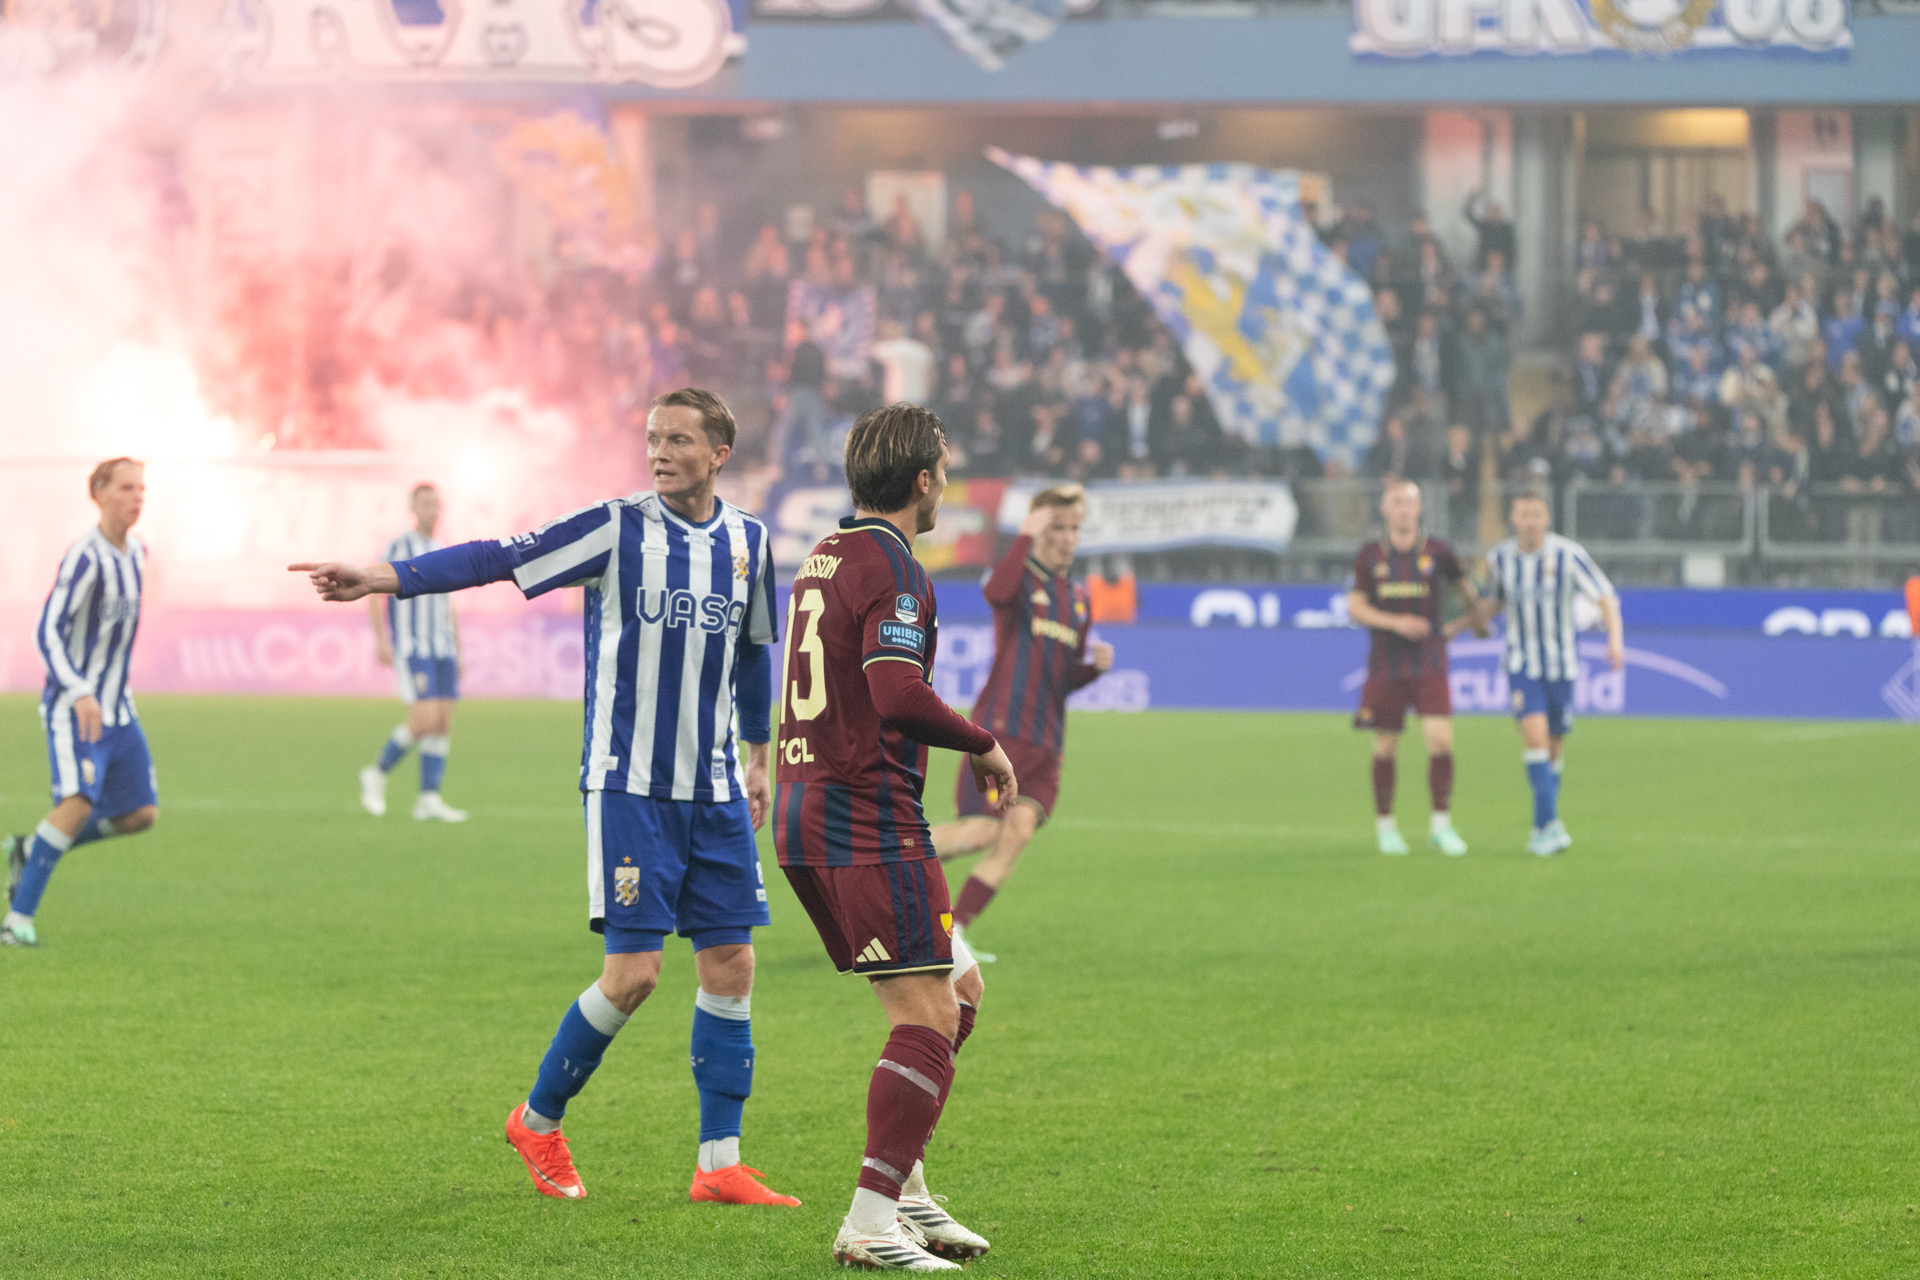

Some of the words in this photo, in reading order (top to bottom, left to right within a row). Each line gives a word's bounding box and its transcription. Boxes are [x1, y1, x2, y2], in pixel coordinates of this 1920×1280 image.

[635, 586, 748, 638] VASA
[882, 625, 924, 645] UNIBET
[780, 588, 827, 724] 13
